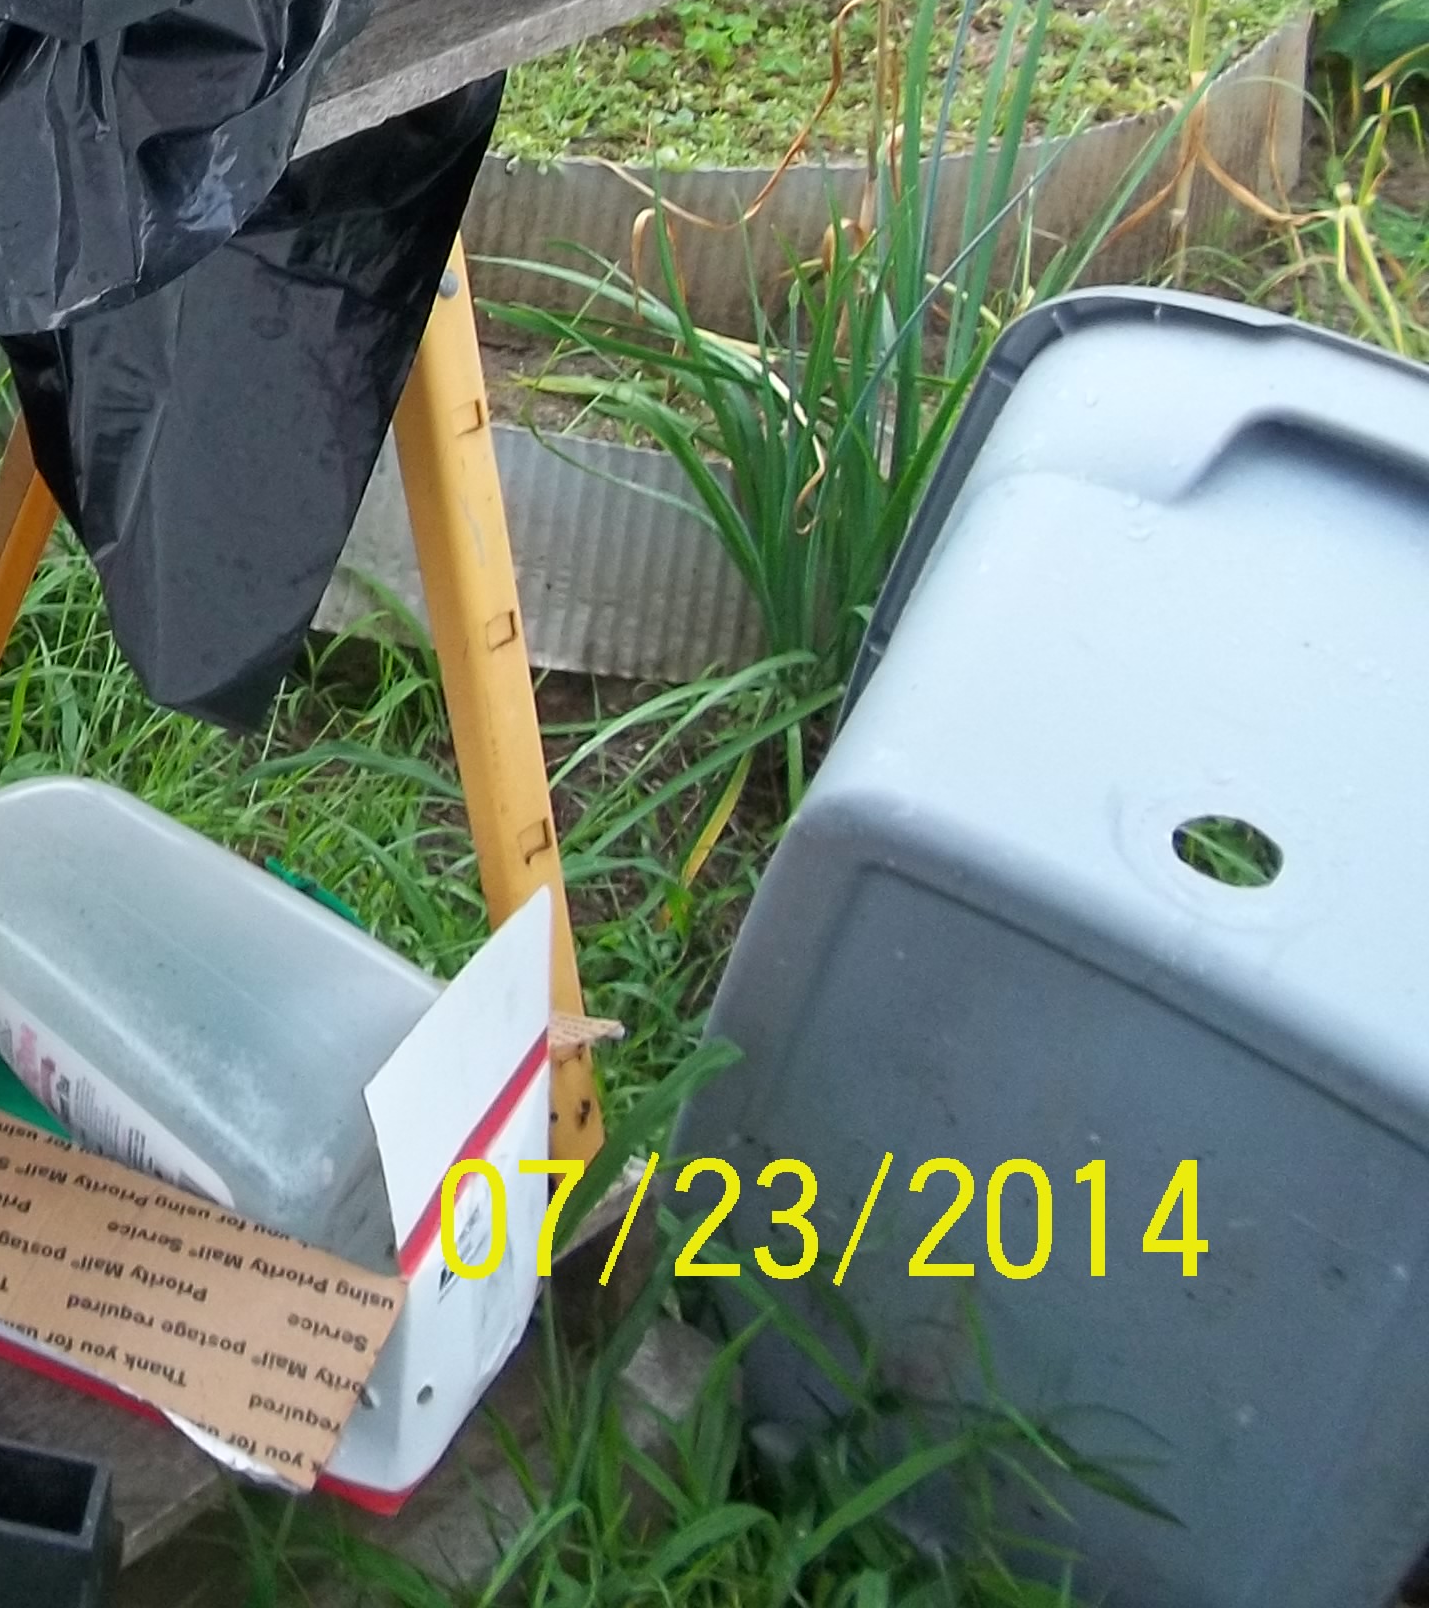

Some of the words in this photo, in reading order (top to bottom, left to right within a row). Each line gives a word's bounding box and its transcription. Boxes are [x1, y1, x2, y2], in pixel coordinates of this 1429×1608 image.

[72, 1173, 149, 1208] Priority
[153, 1194, 210, 1219] using
[106, 1220, 183, 1252] Service
[129, 1264, 207, 1302] Priority
[249, 1256, 328, 1294] Priority
[65, 1293, 154, 1327] required
[334, 1278, 394, 1310] using
[43, 1331, 73, 1352] for
[160, 1319, 247, 1355] postage
[286, 1312, 368, 1352] Service
[79, 1340, 117, 1360] you
[124, 1352, 186, 1387] Thank
